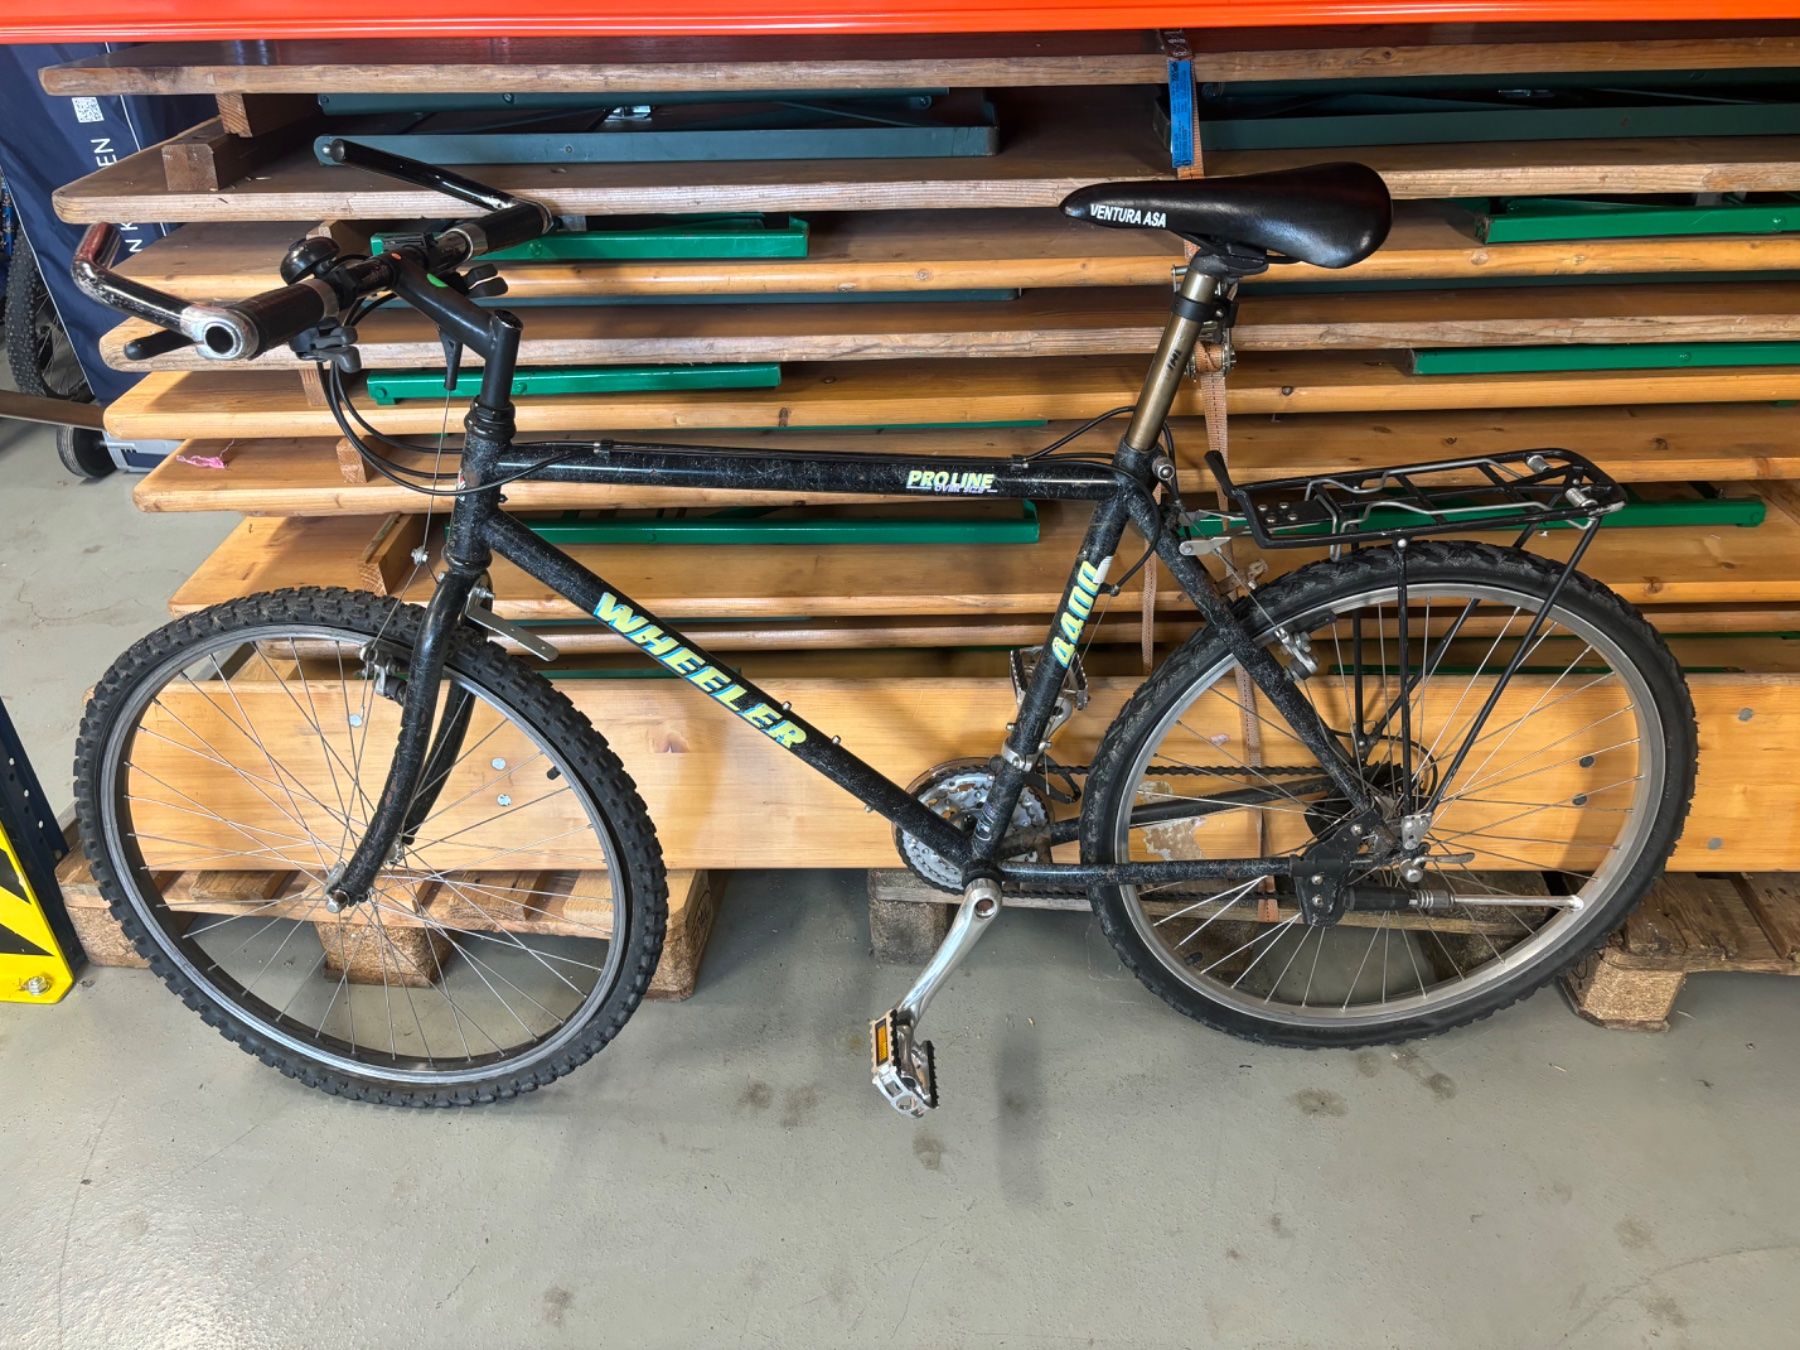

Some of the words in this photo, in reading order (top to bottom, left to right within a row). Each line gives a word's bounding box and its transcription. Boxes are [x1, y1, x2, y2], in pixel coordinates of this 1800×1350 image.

[1090, 203, 1141, 224] VENTURA
[1143, 211, 1166, 228] ASA
[593, 592, 807, 749] WHEELER
